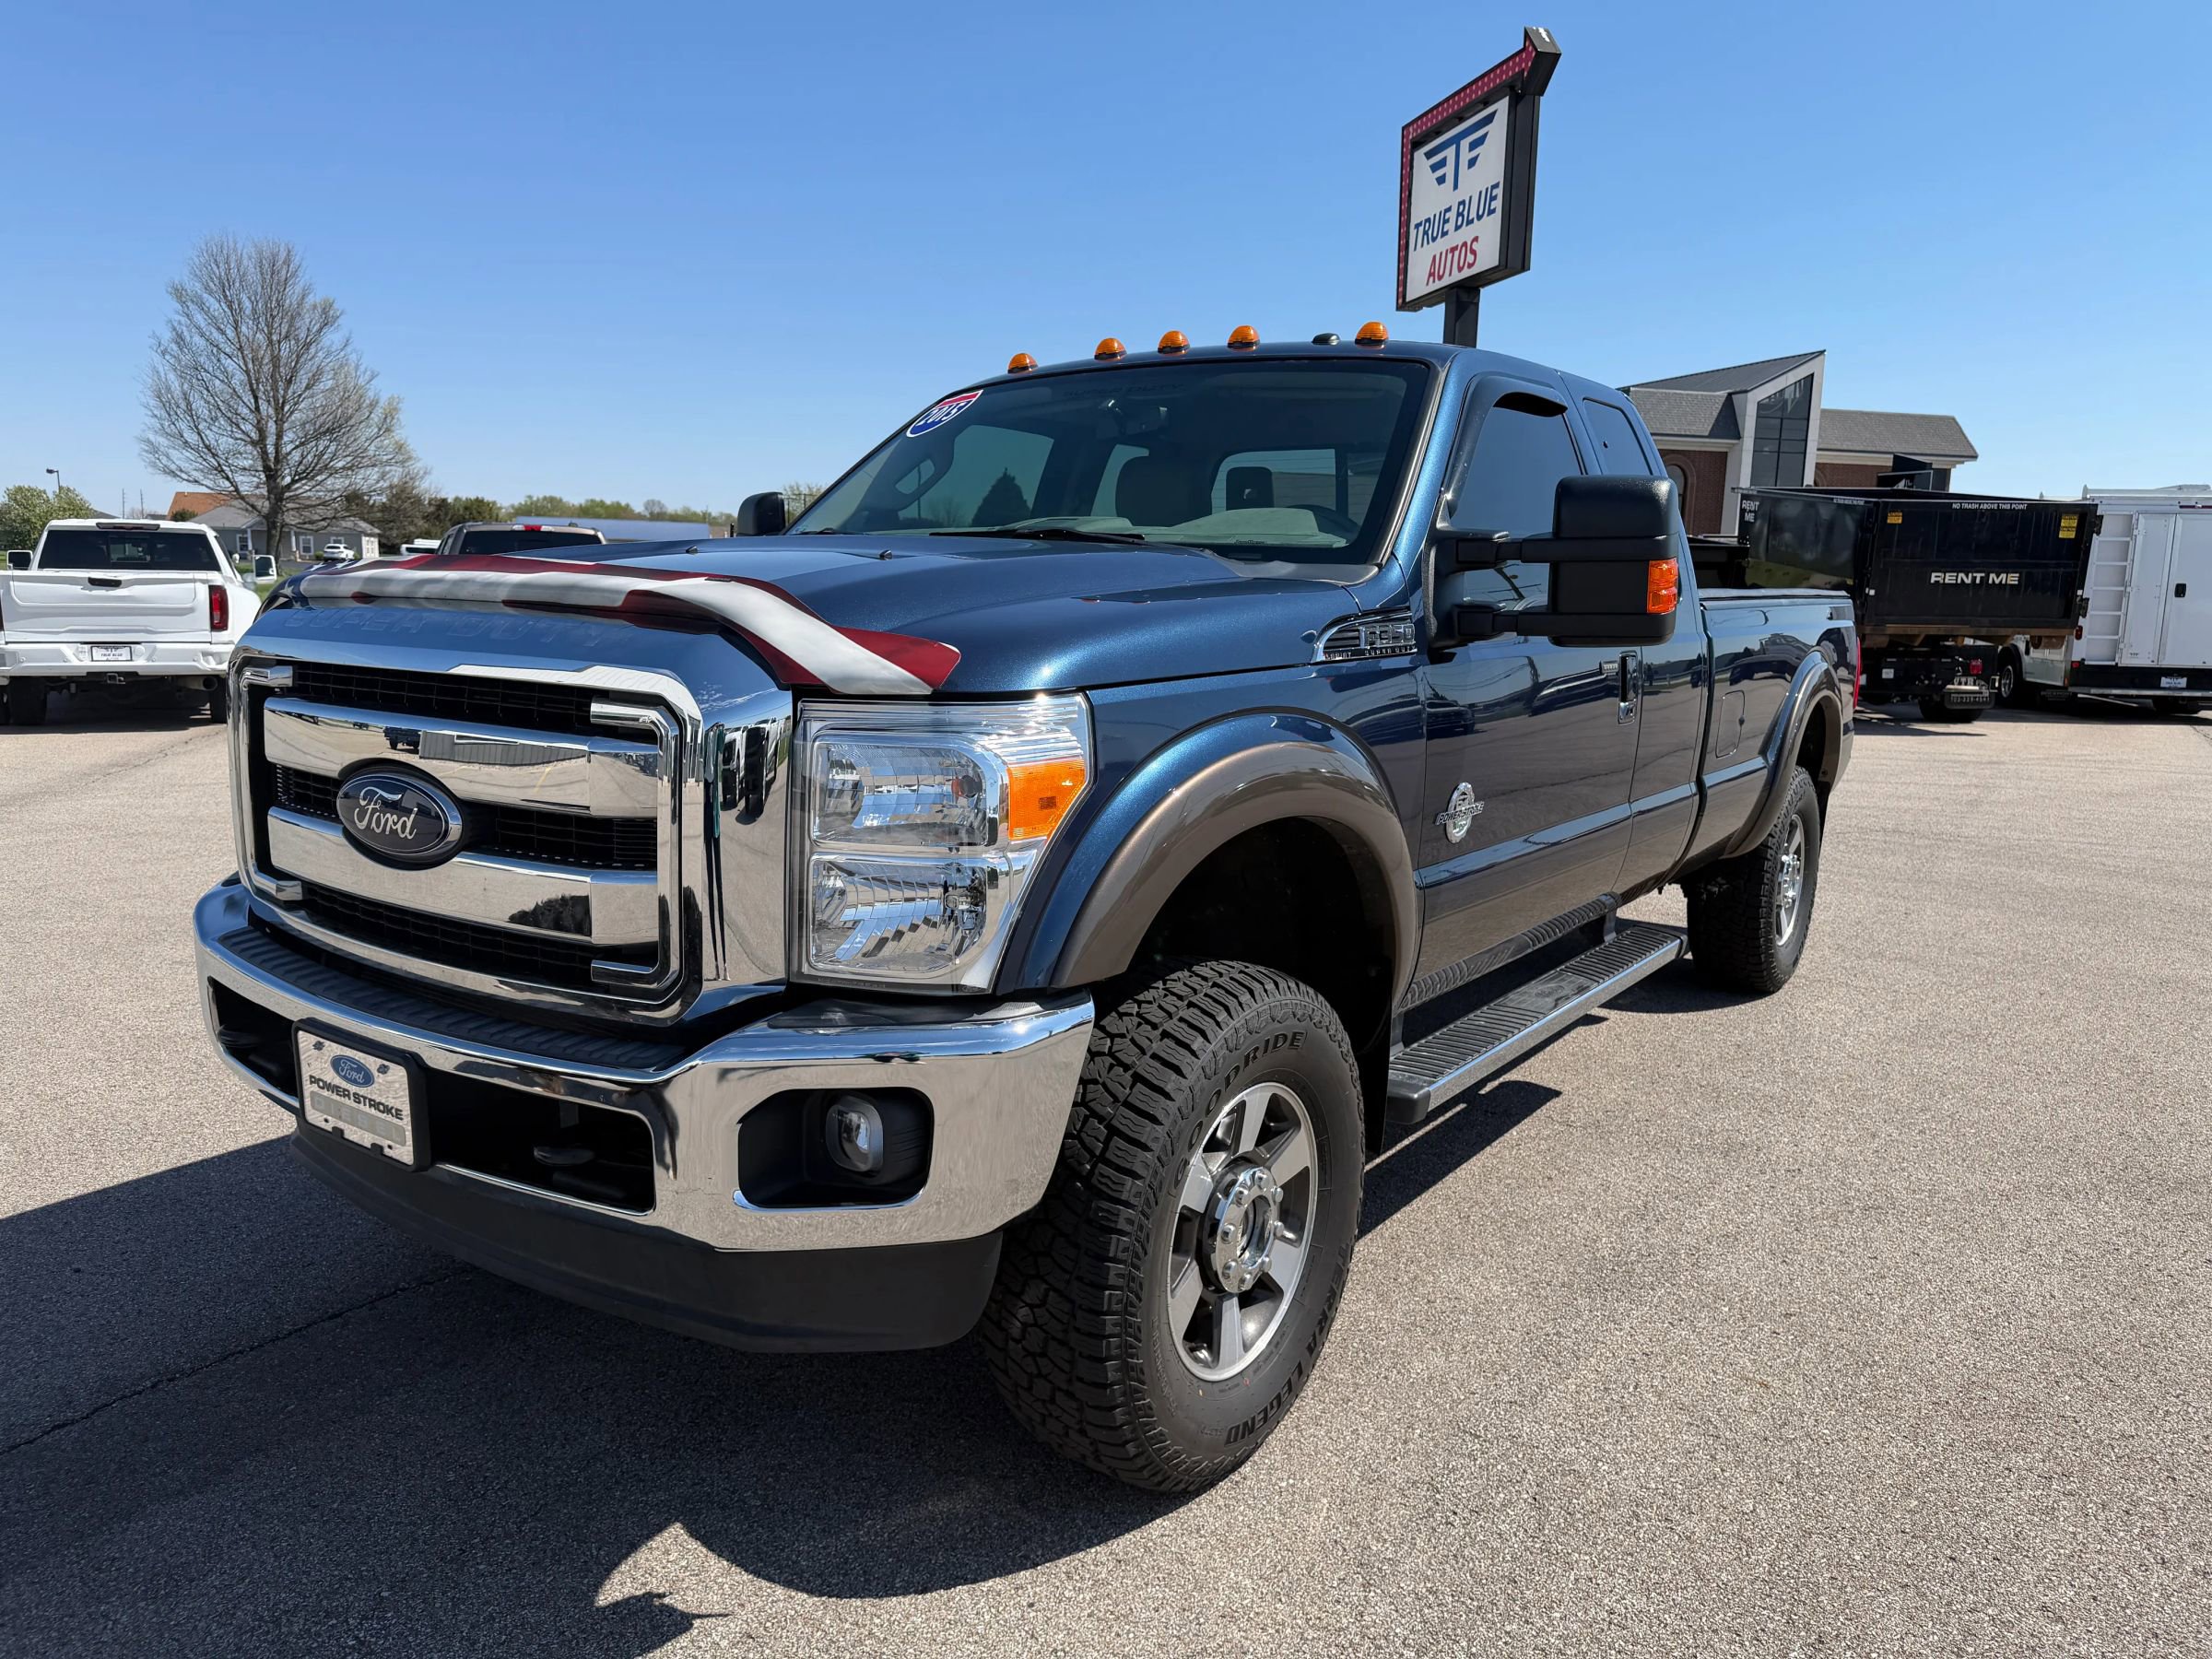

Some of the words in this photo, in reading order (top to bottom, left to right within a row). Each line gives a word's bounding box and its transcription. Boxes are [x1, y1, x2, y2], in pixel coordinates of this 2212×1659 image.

[1413, 205, 1453, 252] TRUE
[1454, 181, 1500, 230] BLUE
[1426, 236, 1479, 287] AUTOS
[914, 401, 969, 427] 2015
[1741, 500, 1759, 512] RENT
[1744, 512, 1755, 523] ME
[1930, 571, 1985, 584] RENT
[1988, 572, 2020, 585] ME
[354, 786, 418, 840] Ford
[338, 1059, 365, 1084] Ford
[309, 1075, 351, 1100] POWER
[352, 1091, 404, 1121] STROKE
[1174, 1030, 1307, 1189] GOODRIDE
[1224, 1359, 1303, 1446] LEGEND
